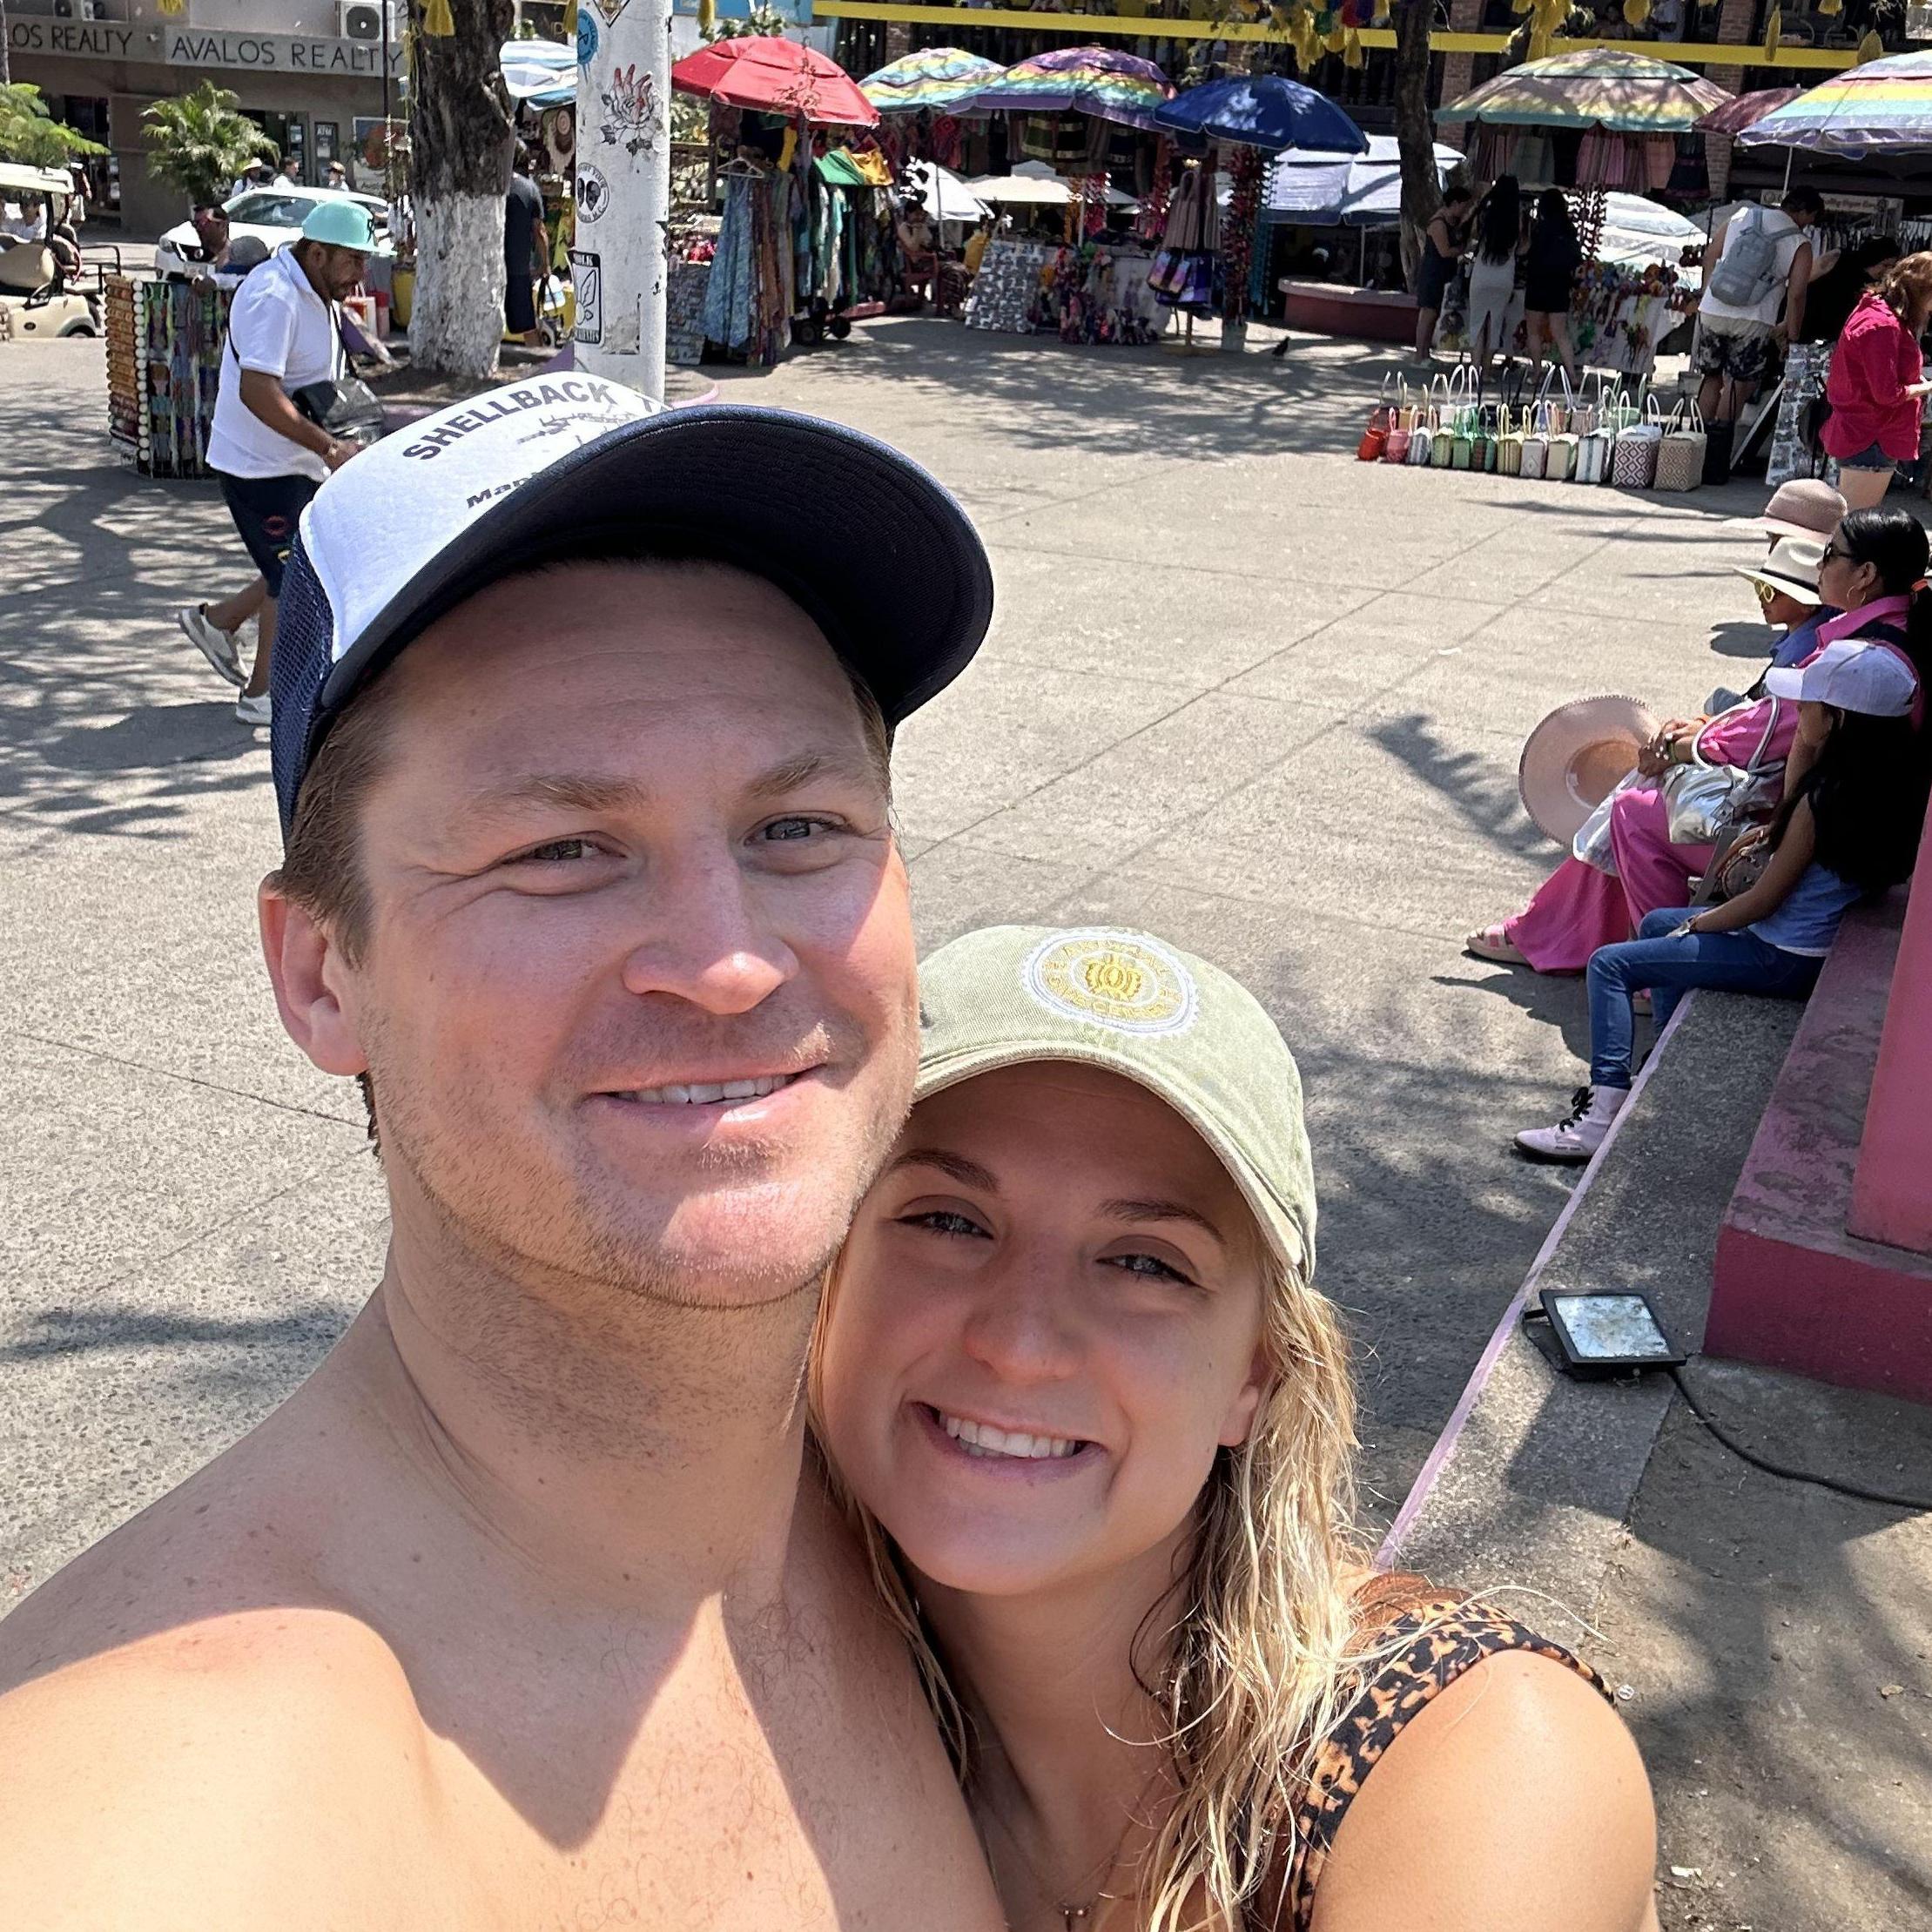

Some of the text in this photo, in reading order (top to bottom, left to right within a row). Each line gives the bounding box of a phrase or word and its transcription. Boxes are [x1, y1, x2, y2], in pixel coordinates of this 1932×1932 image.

[51, 25, 133, 56] REALTY
[171, 36, 403, 72] AVALOS REALTY
[402, 380, 619, 461] SHELLBACK
